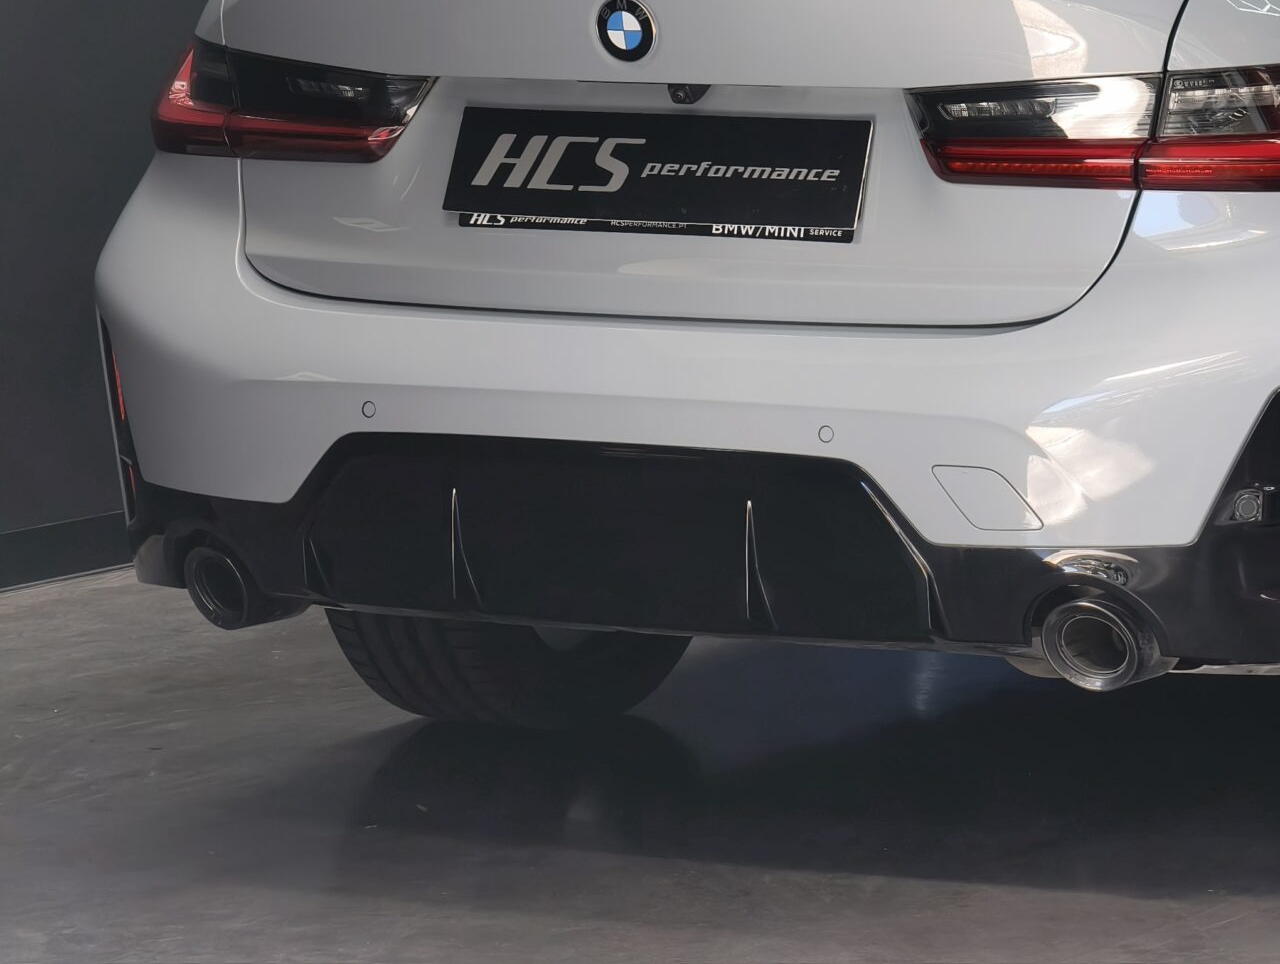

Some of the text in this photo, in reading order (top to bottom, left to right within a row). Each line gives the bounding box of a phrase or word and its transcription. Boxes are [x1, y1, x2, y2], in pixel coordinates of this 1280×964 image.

[601, 0, 648, 21] BMW
[471, 133, 841, 193] HCS performance
[809, 228, 843, 237] SERVICE
